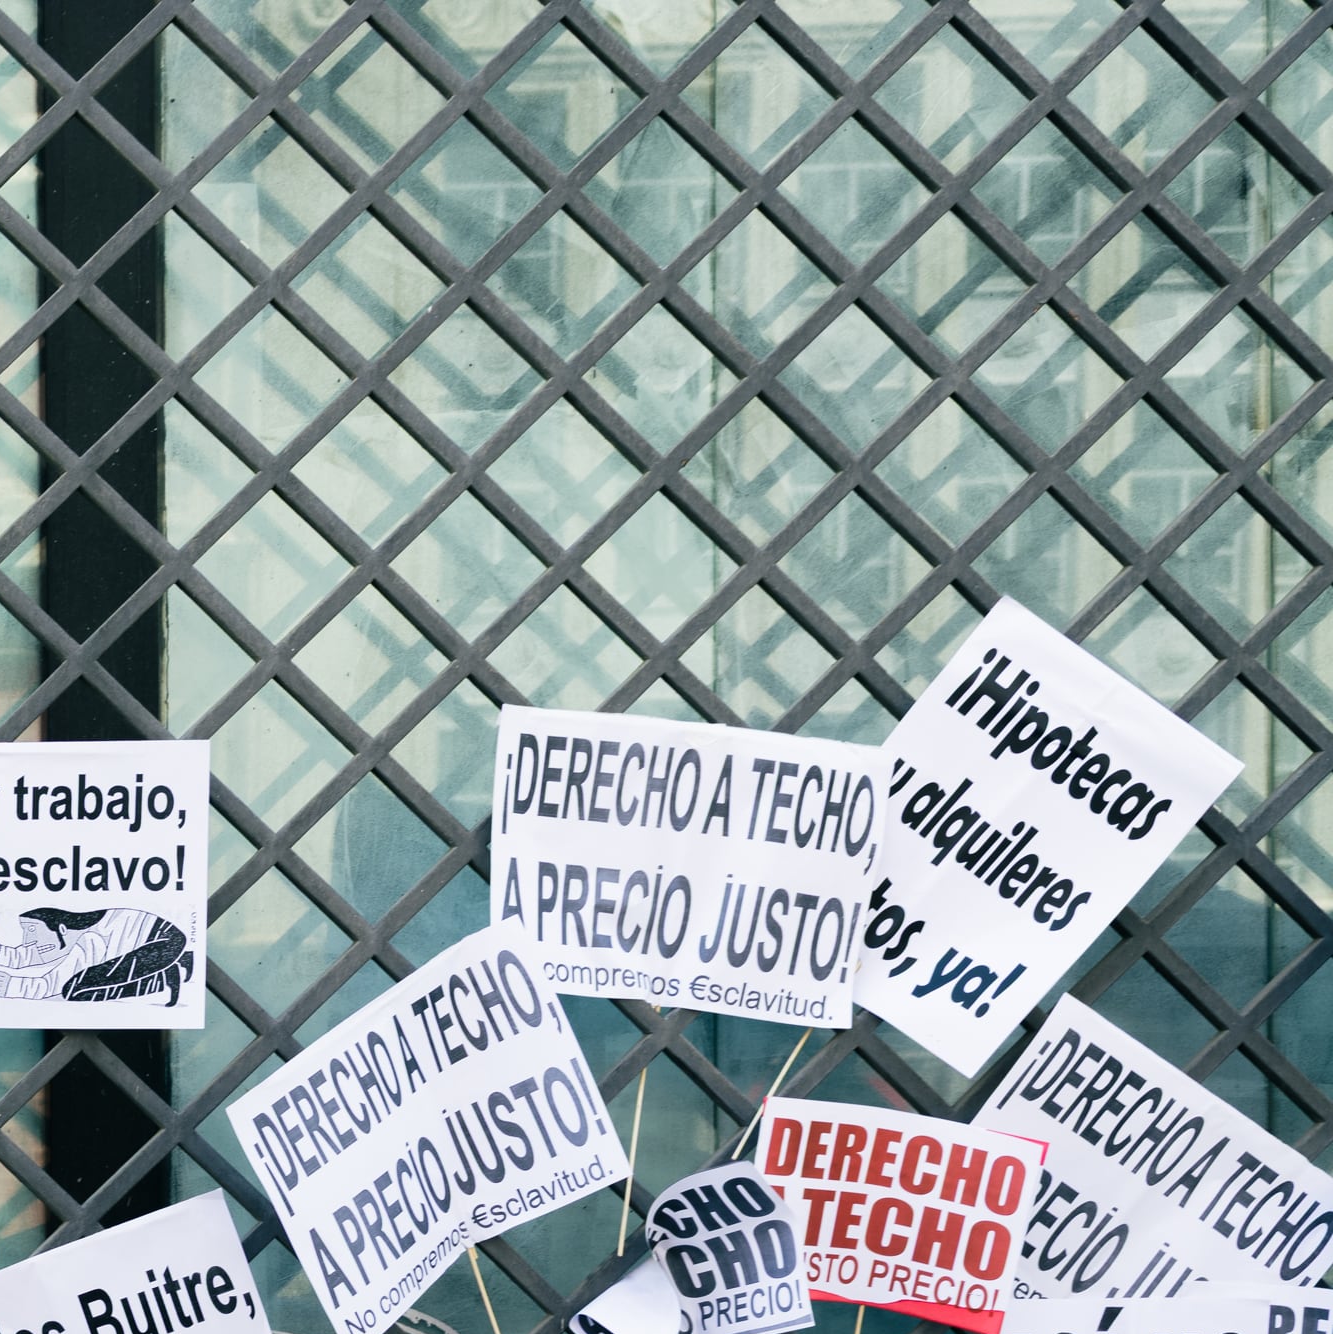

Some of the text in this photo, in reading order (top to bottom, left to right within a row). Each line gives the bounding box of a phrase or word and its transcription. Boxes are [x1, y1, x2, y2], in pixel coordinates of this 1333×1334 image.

[945, 648, 1173, 840] ¡Hipotecas
[14, 774, 187, 832] trabajo,
[501, 733, 878, 876] ¡DERECHO A TECHO,
[901, 779, 1092, 932] alquileres
[543, 960, 833, 1021] compremos €sclavitud.
[911, 948, 1027, 1018] ya!
[253, 950, 562, 1217] ¡DERECHO A TECHO,
[995, 1028, 1230, 1208] ¡DERECHO A
[767, 1118, 1027, 1216] DERECHO
[309, 1228, 358, 1310] A
[379, 1222, 469, 1316] compremos
[471, 1156, 614, 1230] €sclavitud.
[805, 1191, 1013, 1280] TECHO
[867, 1261, 999, 1318] PRECIO!
